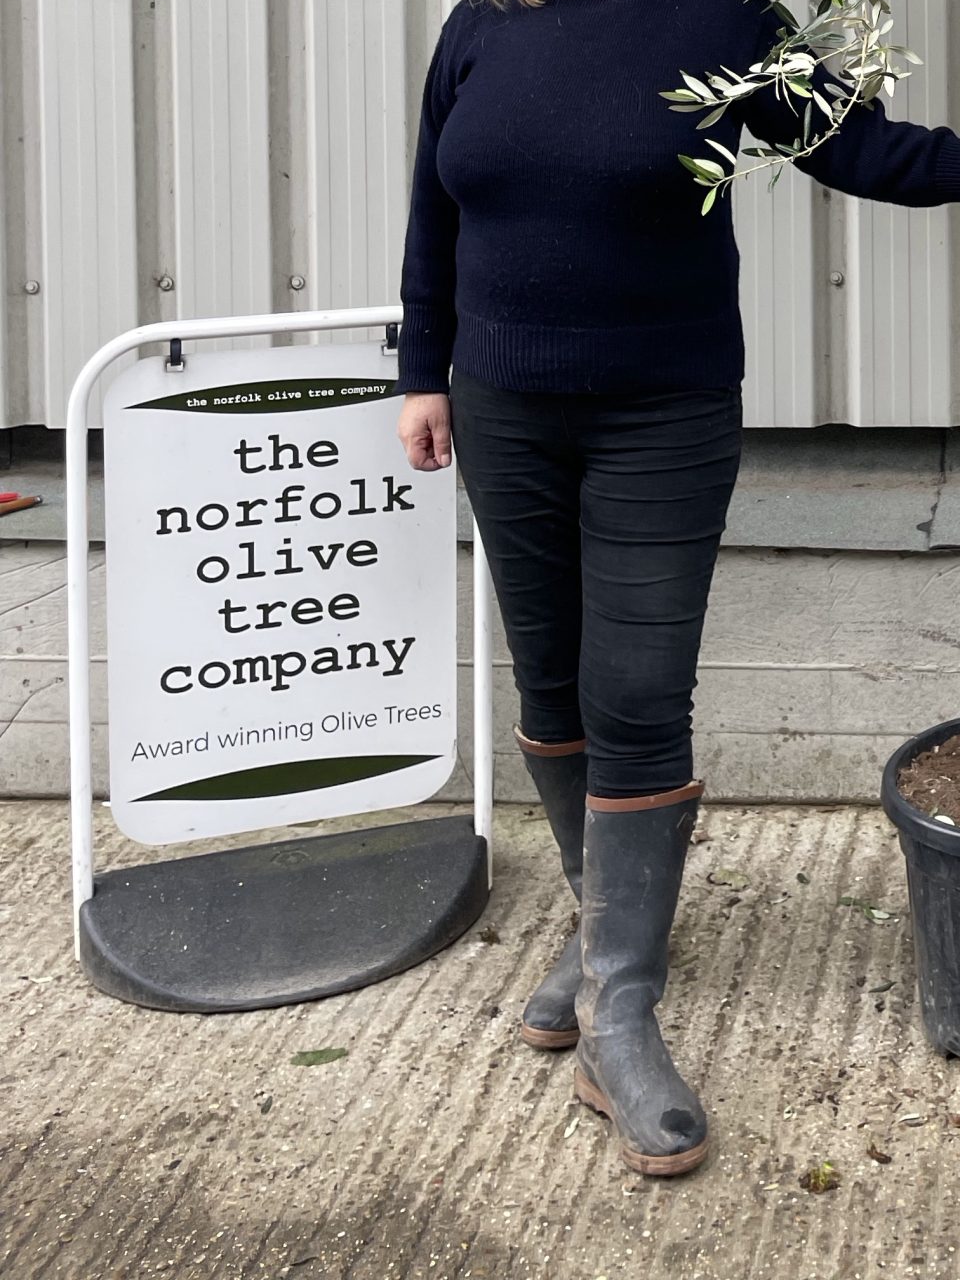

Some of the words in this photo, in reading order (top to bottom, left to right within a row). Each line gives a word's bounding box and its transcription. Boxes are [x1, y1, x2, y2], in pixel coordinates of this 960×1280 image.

[186, 397, 208, 407] the
[213, 393, 262, 405] norfolk
[267, 389, 302, 401] olive
[308, 388, 335, 398] tree
[340, 384, 387, 397] company
[234, 434, 339, 474] the
[156, 476, 416, 536] norfolk
[196, 537, 378, 584] olive
[217, 593, 360, 634] tree
[160, 636, 416, 693] company
[130, 731, 209, 762] Award
[217, 721, 313, 749] winning
[321, 711, 378, 734] Olive
[384, 703, 442, 725] Trees
